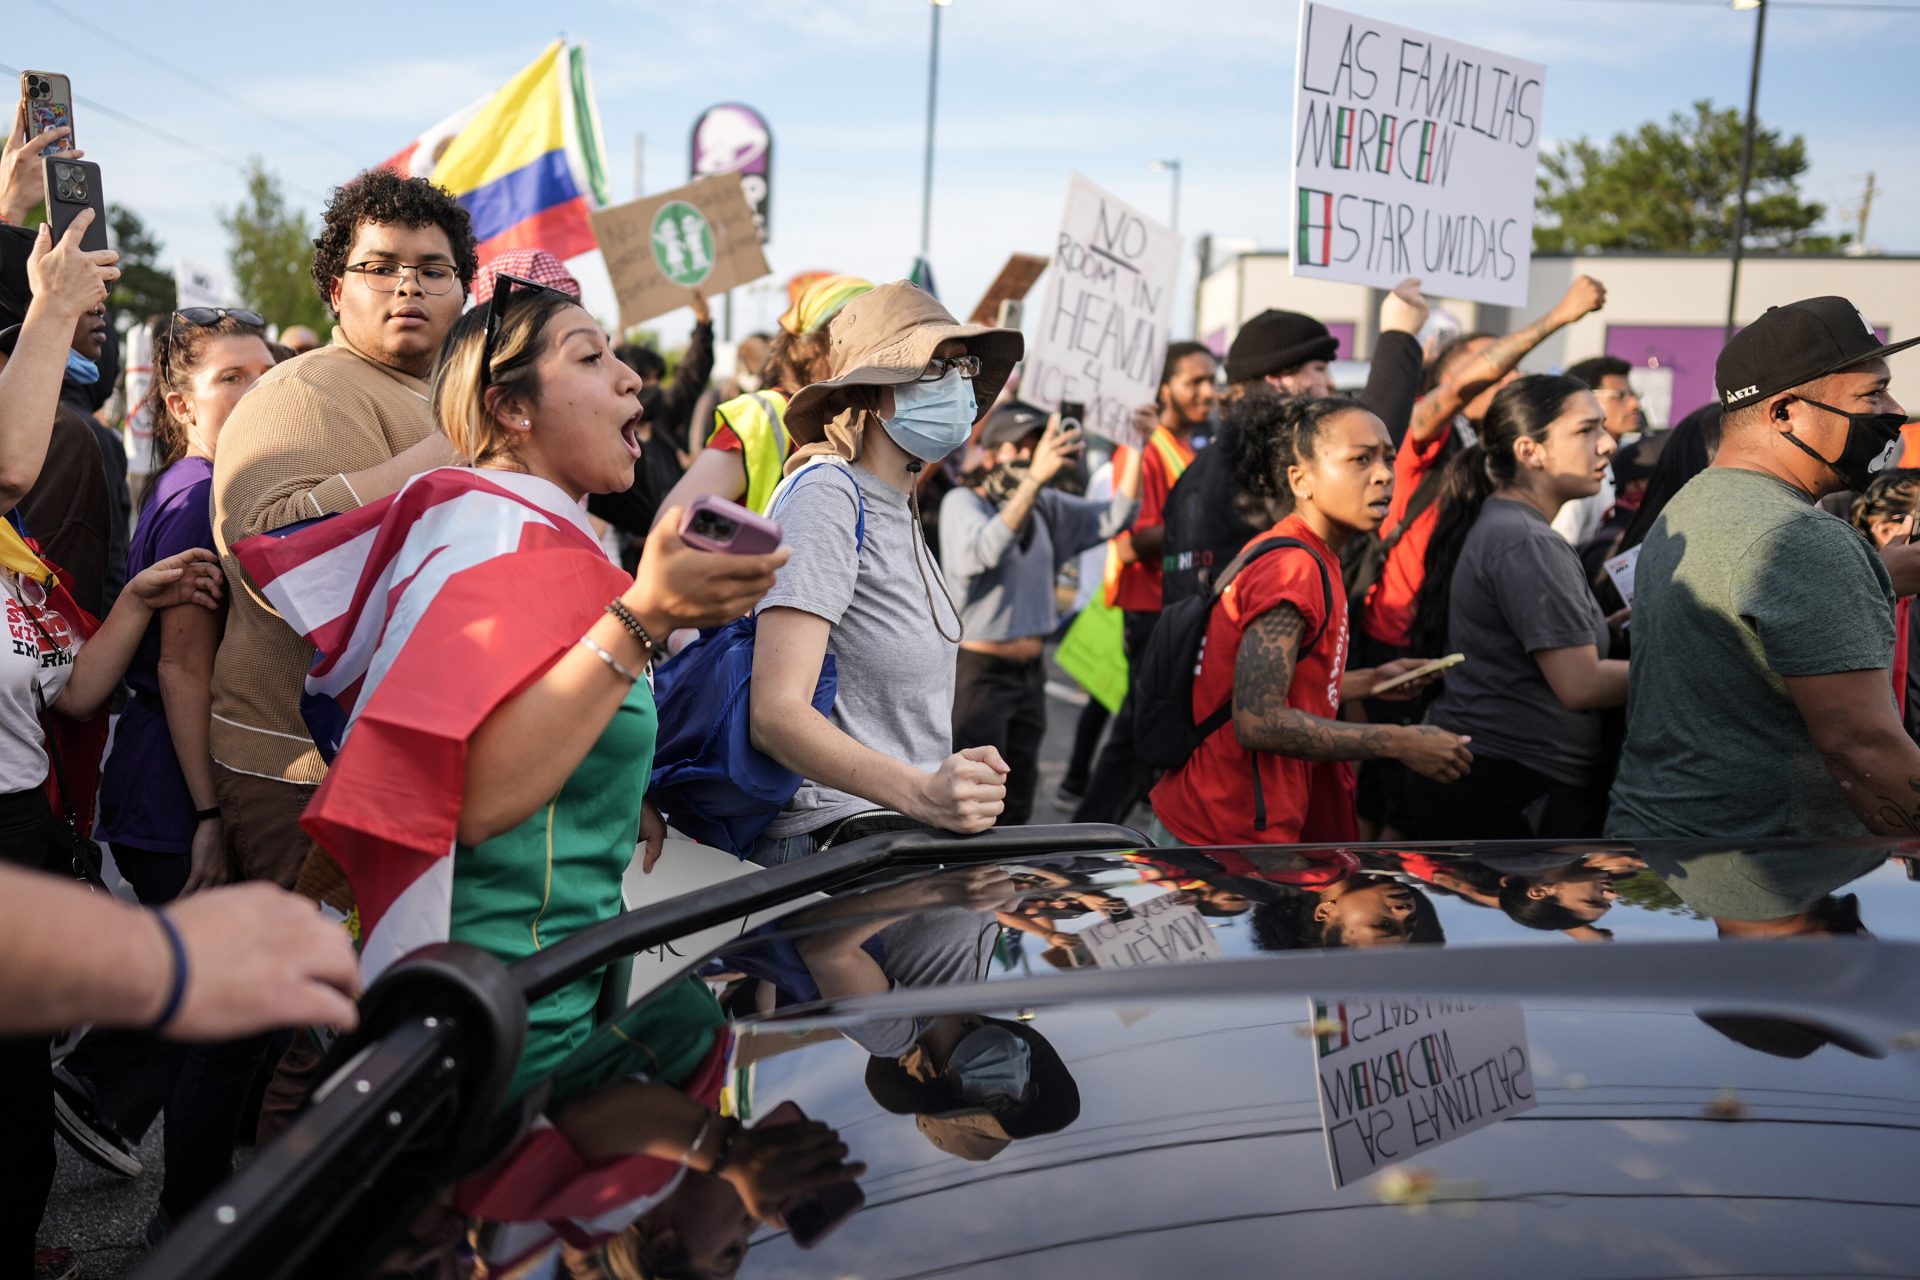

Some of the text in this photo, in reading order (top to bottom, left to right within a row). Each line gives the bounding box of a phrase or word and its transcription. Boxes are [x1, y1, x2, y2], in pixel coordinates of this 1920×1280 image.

[1303, 2, 1540, 149] LAS FAMILIAS
[1297, 99, 1457, 187] MERECEN
[1093, 199, 1148, 259] NO
[1299, 186, 1517, 281] ESTAR UNIDAS
[1055, 232, 1162, 315] ROOM IN
[1050, 276, 1156, 388] HEAVEN
[1082, 358, 1104, 391] 4
[1030, 359, 1078, 402] ICE
